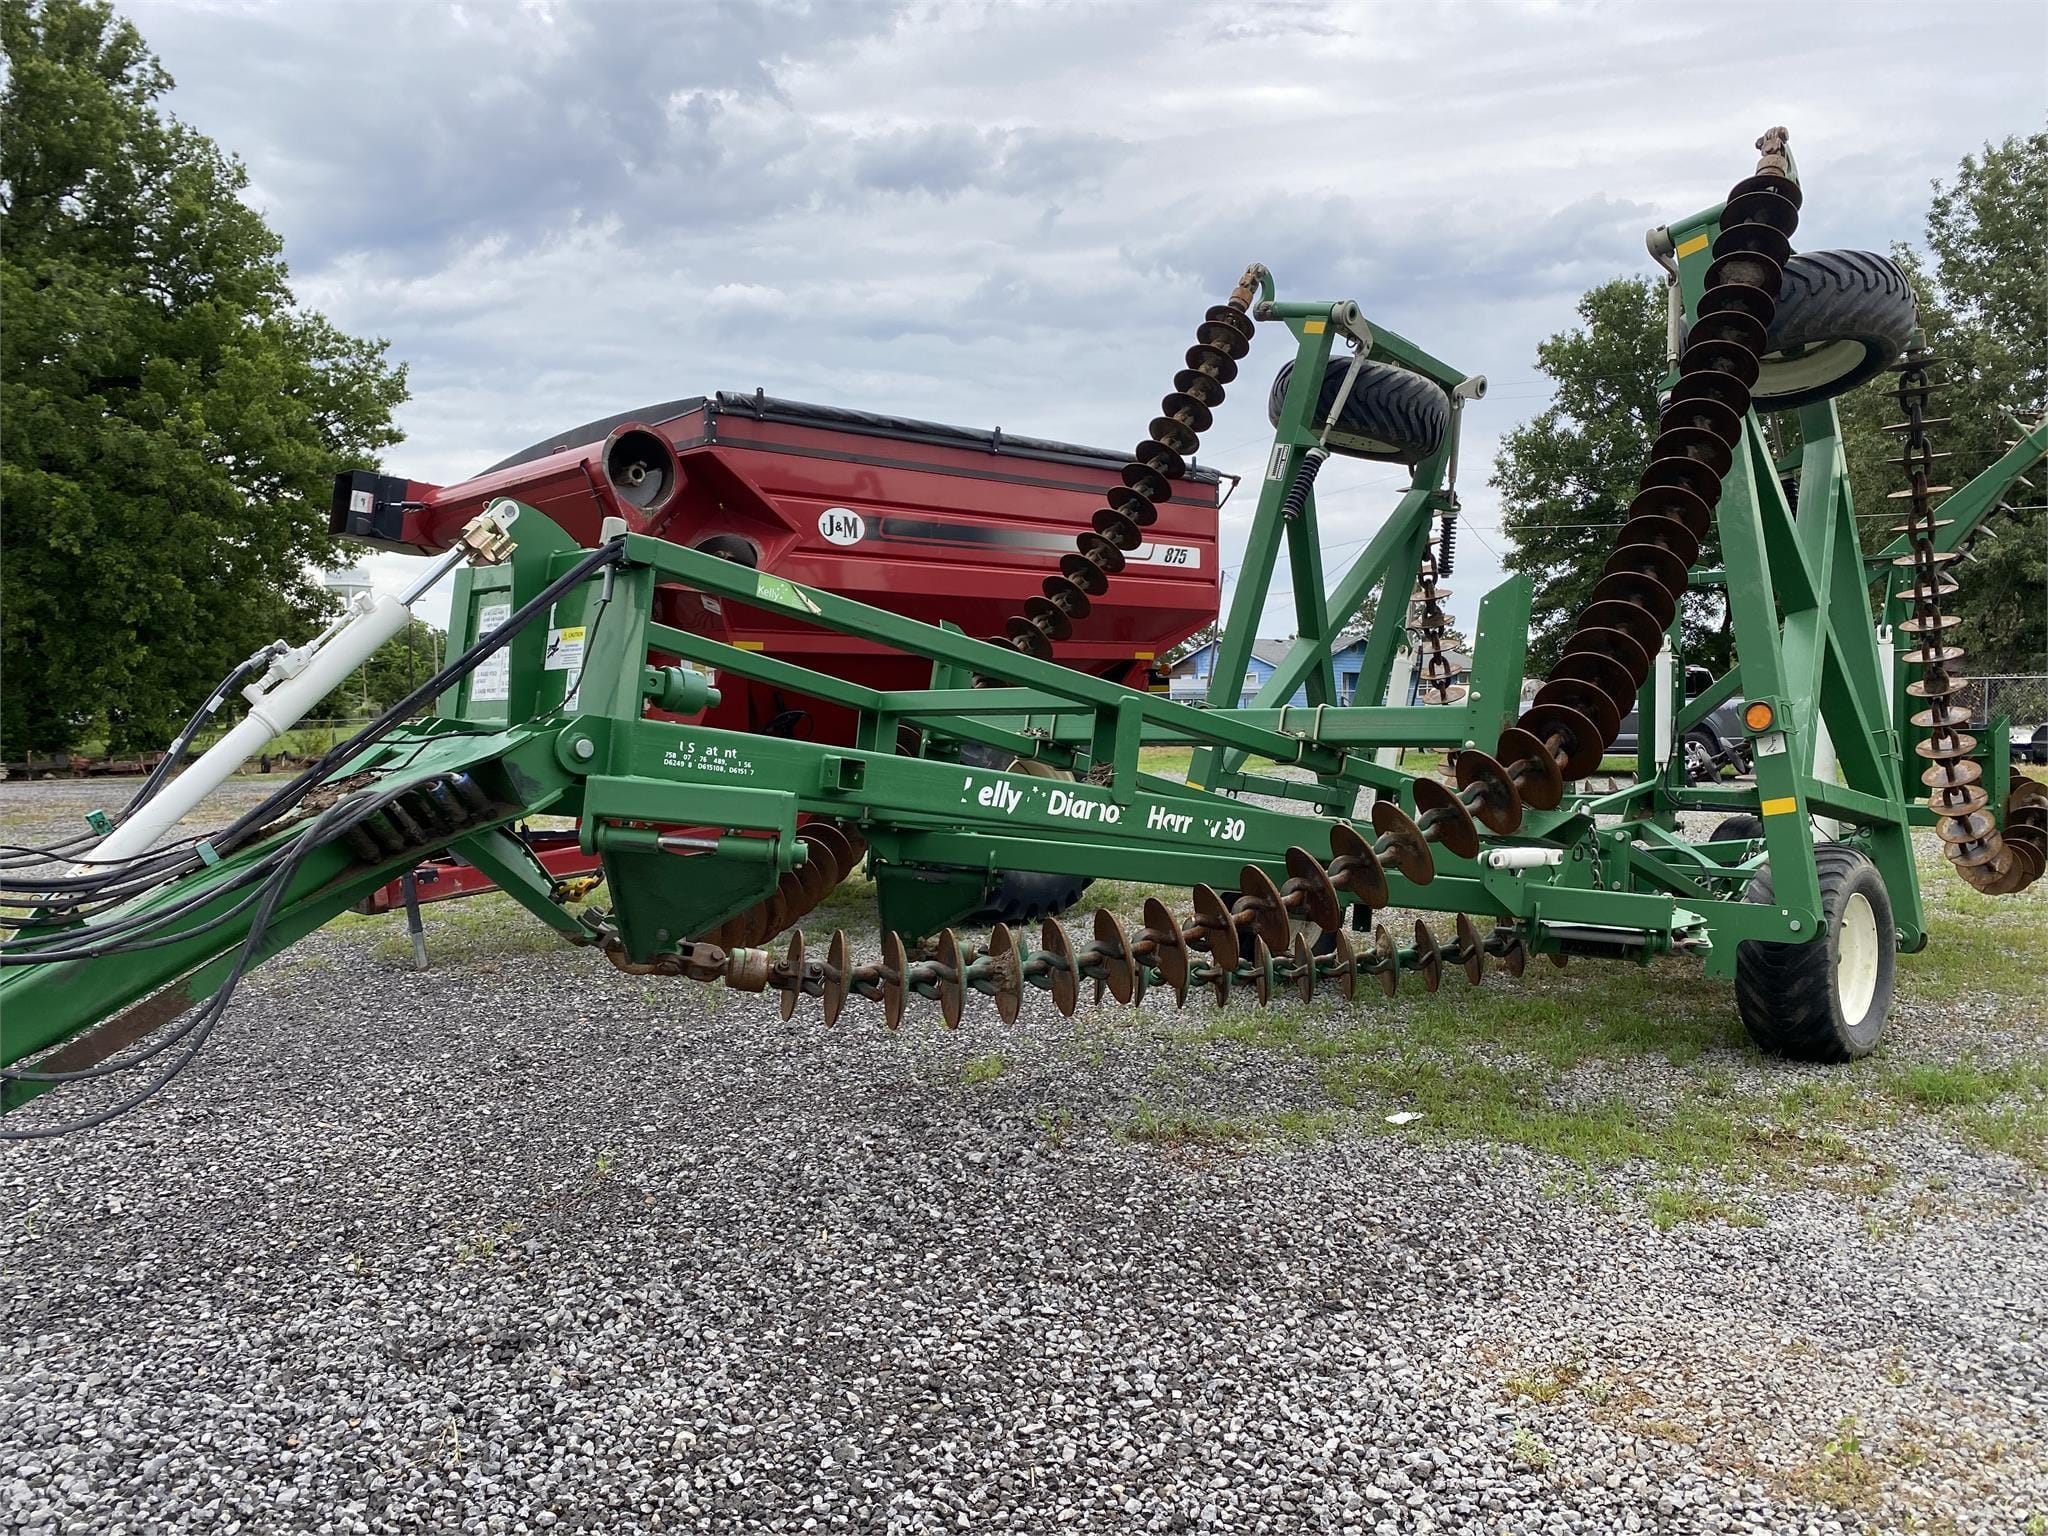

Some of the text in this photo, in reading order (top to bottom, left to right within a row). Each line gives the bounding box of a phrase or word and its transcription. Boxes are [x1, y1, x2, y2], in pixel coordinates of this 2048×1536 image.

[822, 515, 858, 538] J&M
[1164, 547, 1188, 564] 875
[758, 585, 780, 601] Kelly
[703, 746, 738, 759] atnt
[1221, 817, 1245, 842] 30
